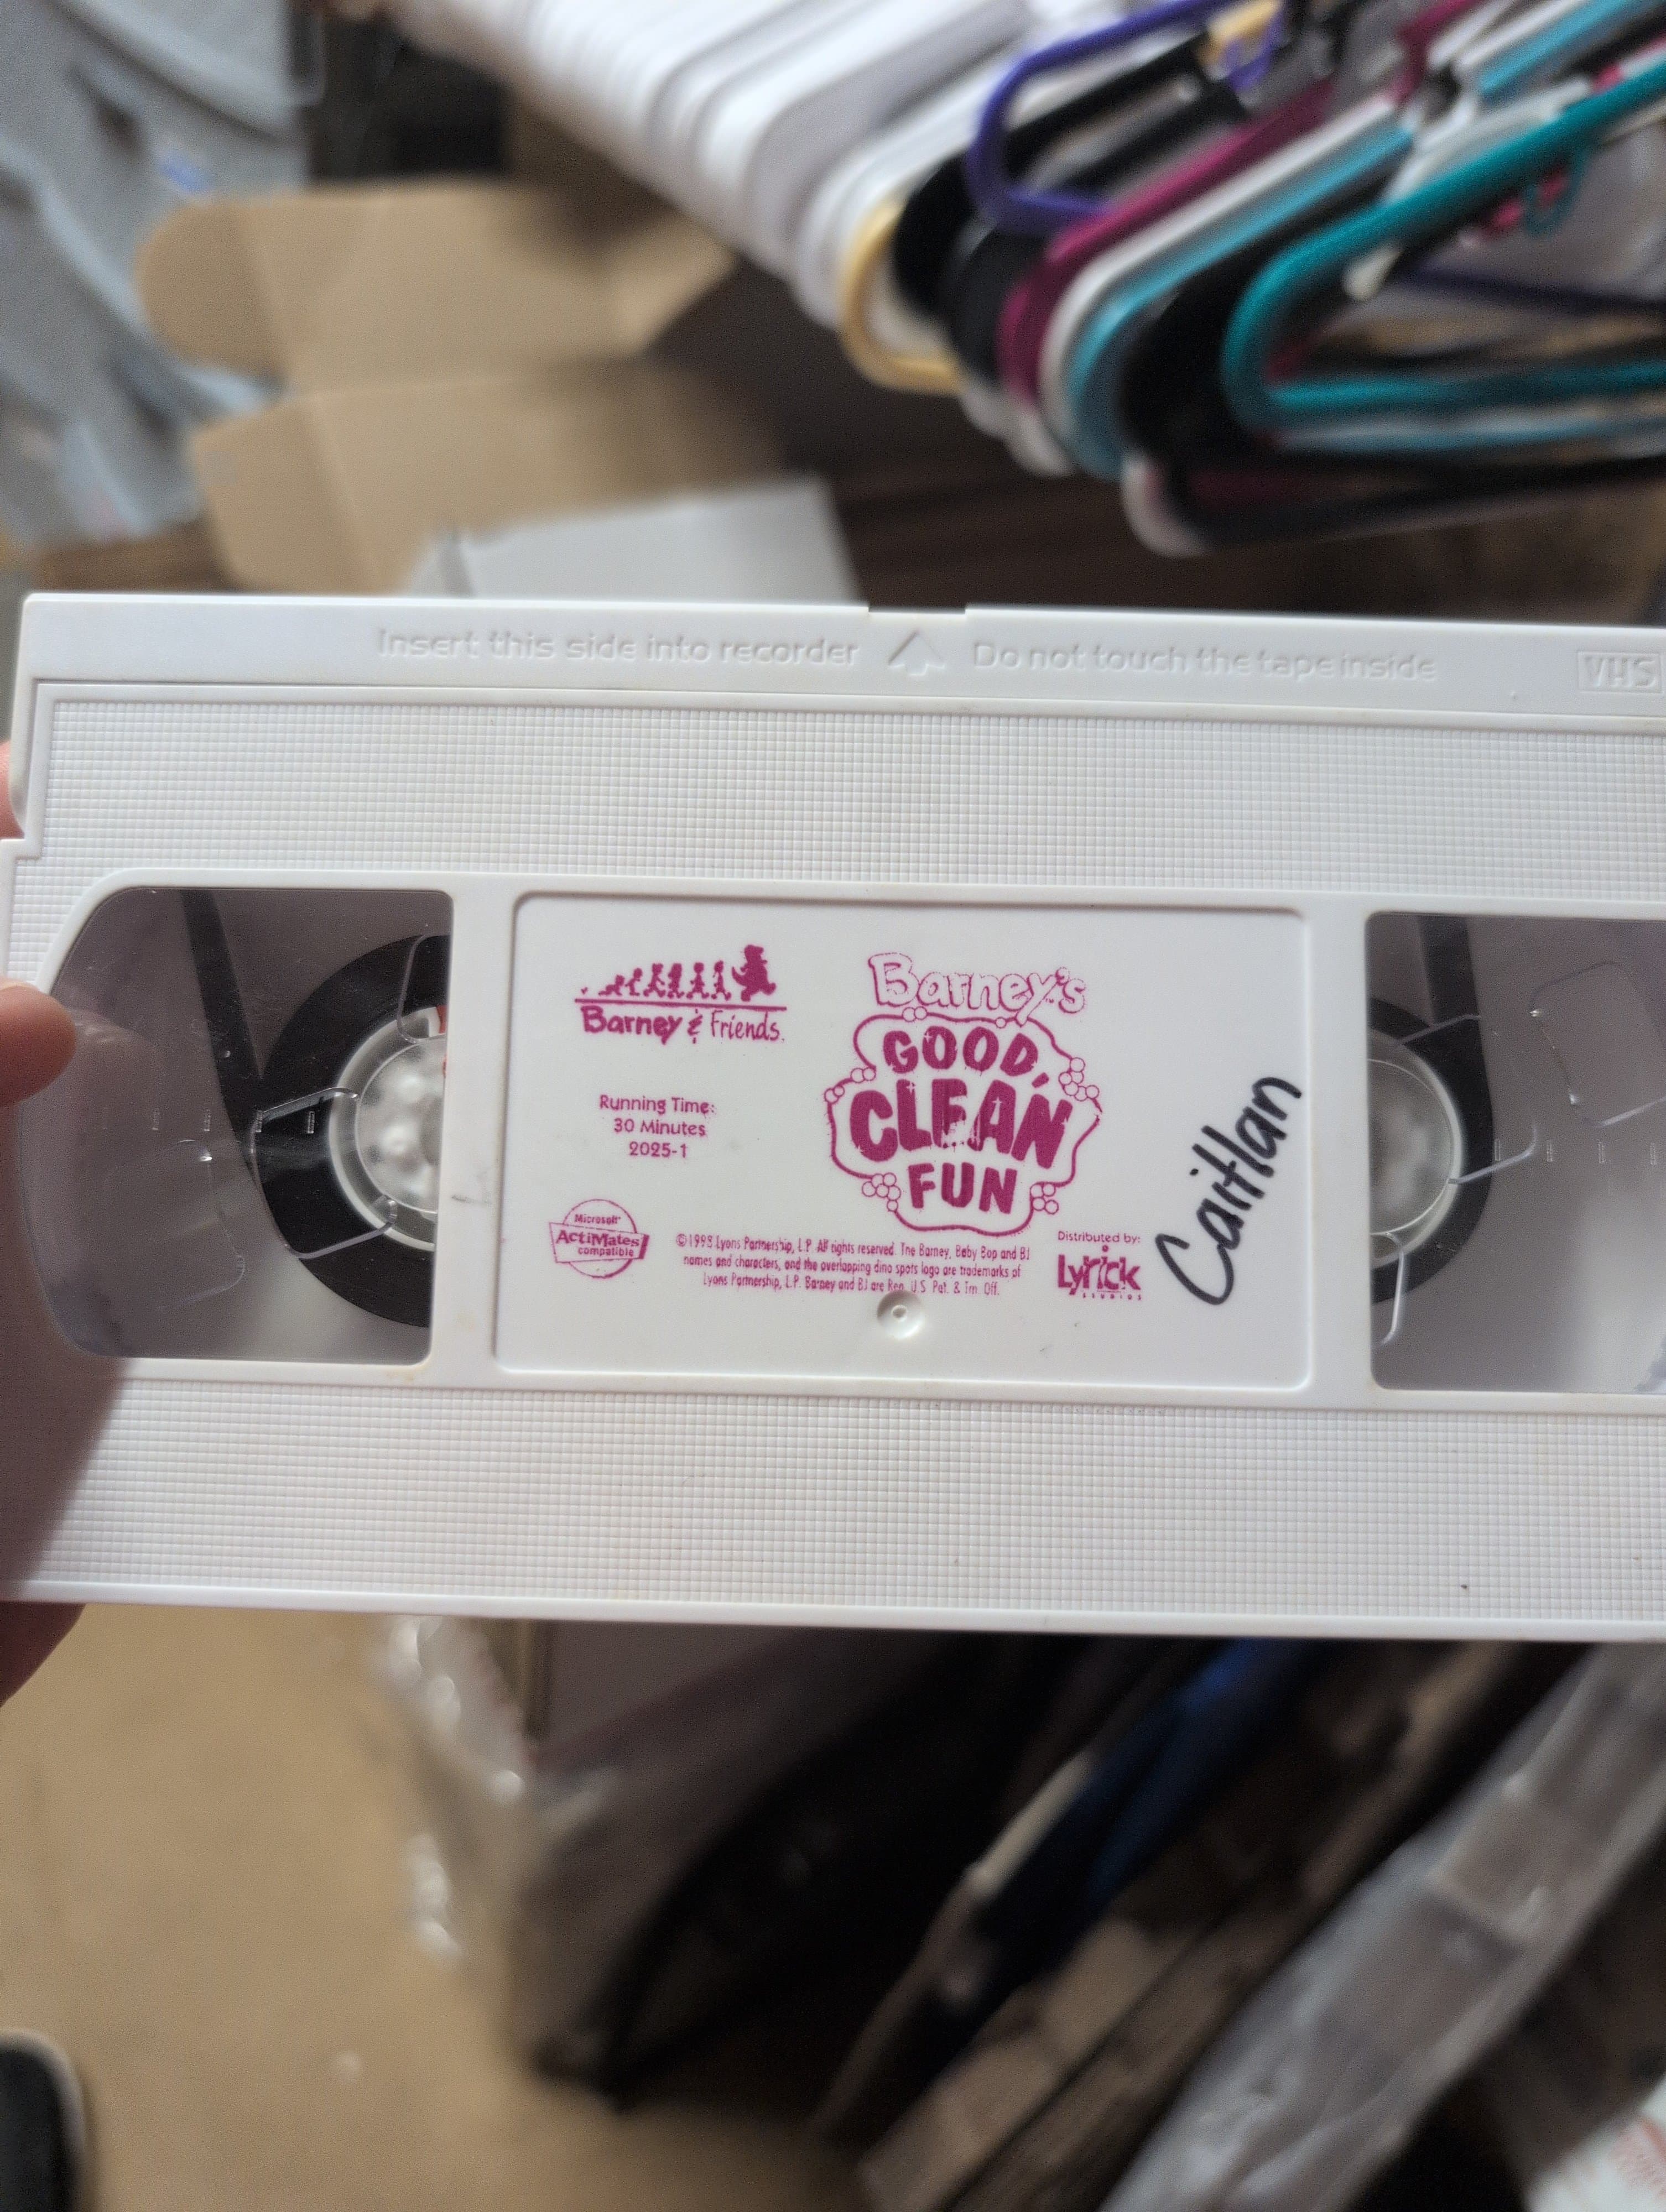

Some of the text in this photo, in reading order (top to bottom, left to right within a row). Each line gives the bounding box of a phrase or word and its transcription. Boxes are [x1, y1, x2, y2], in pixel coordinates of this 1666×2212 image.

[377, 629, 858, 665] Insert this side into recorder
[974, 643, 1436, 681] Do not touch the tape inside
[1584, 656, 1658, 686] VHS
[580, 1005, 683, 1045] Barney
[687, 1008, 703, 1044] &
[600, 1094, 715, 1115] Running Time:
[614, 1118, 706, 1136] 30 Minutes
[850, 1078, 1073, 1169] CLEAN
[629, 1141, 688, 1158] 2025-1
[908, 1162, 1018, 1214] FUN
[1155, 1077, 1302, 1305] Caitlan
[555, 1229, 640, 1247] ActiMates
[716, 1235, 741, 1251] Lyons
[831, 1239, 855, 1256] rights
[900, 1242, 915, 1256] The
[956, 1245, 977, 1261] Baby
[981, 1245, 997, 1261] Bop
[1001, 1245, 1017, 1260] and
[1058, 1230, 1141, 1244] Distributed by:
[577, 1247, 634, 1257] compatible
[684, 1256, 712, 1266] names
[716, 1254, 732, 1267] and
[735, 1254, 780, 1271] characters,
[784, 1256, 801, 1270] and
[804, 1257, 818, 1271] the
[821, 1258, 871, 1276] overlapping
[874, 1259, 892, 1274] dino
[921, 1261, 939, 1279] logo
[943, 1266, 956, 1276] are
[960, 1263, 1009, 1277] trademarks
[1012, 1264, 1021, 1279] of
[1058, 1245, 1141, 1295] Lyrick
[703, 1272, 728, 1287] Lyons
[805, 1276, 836, 1292] Barney
[839, 1276, 855, 1290] and
[871, 1281, 884, 1292] are
[954, 1281, 960, 1293] &
